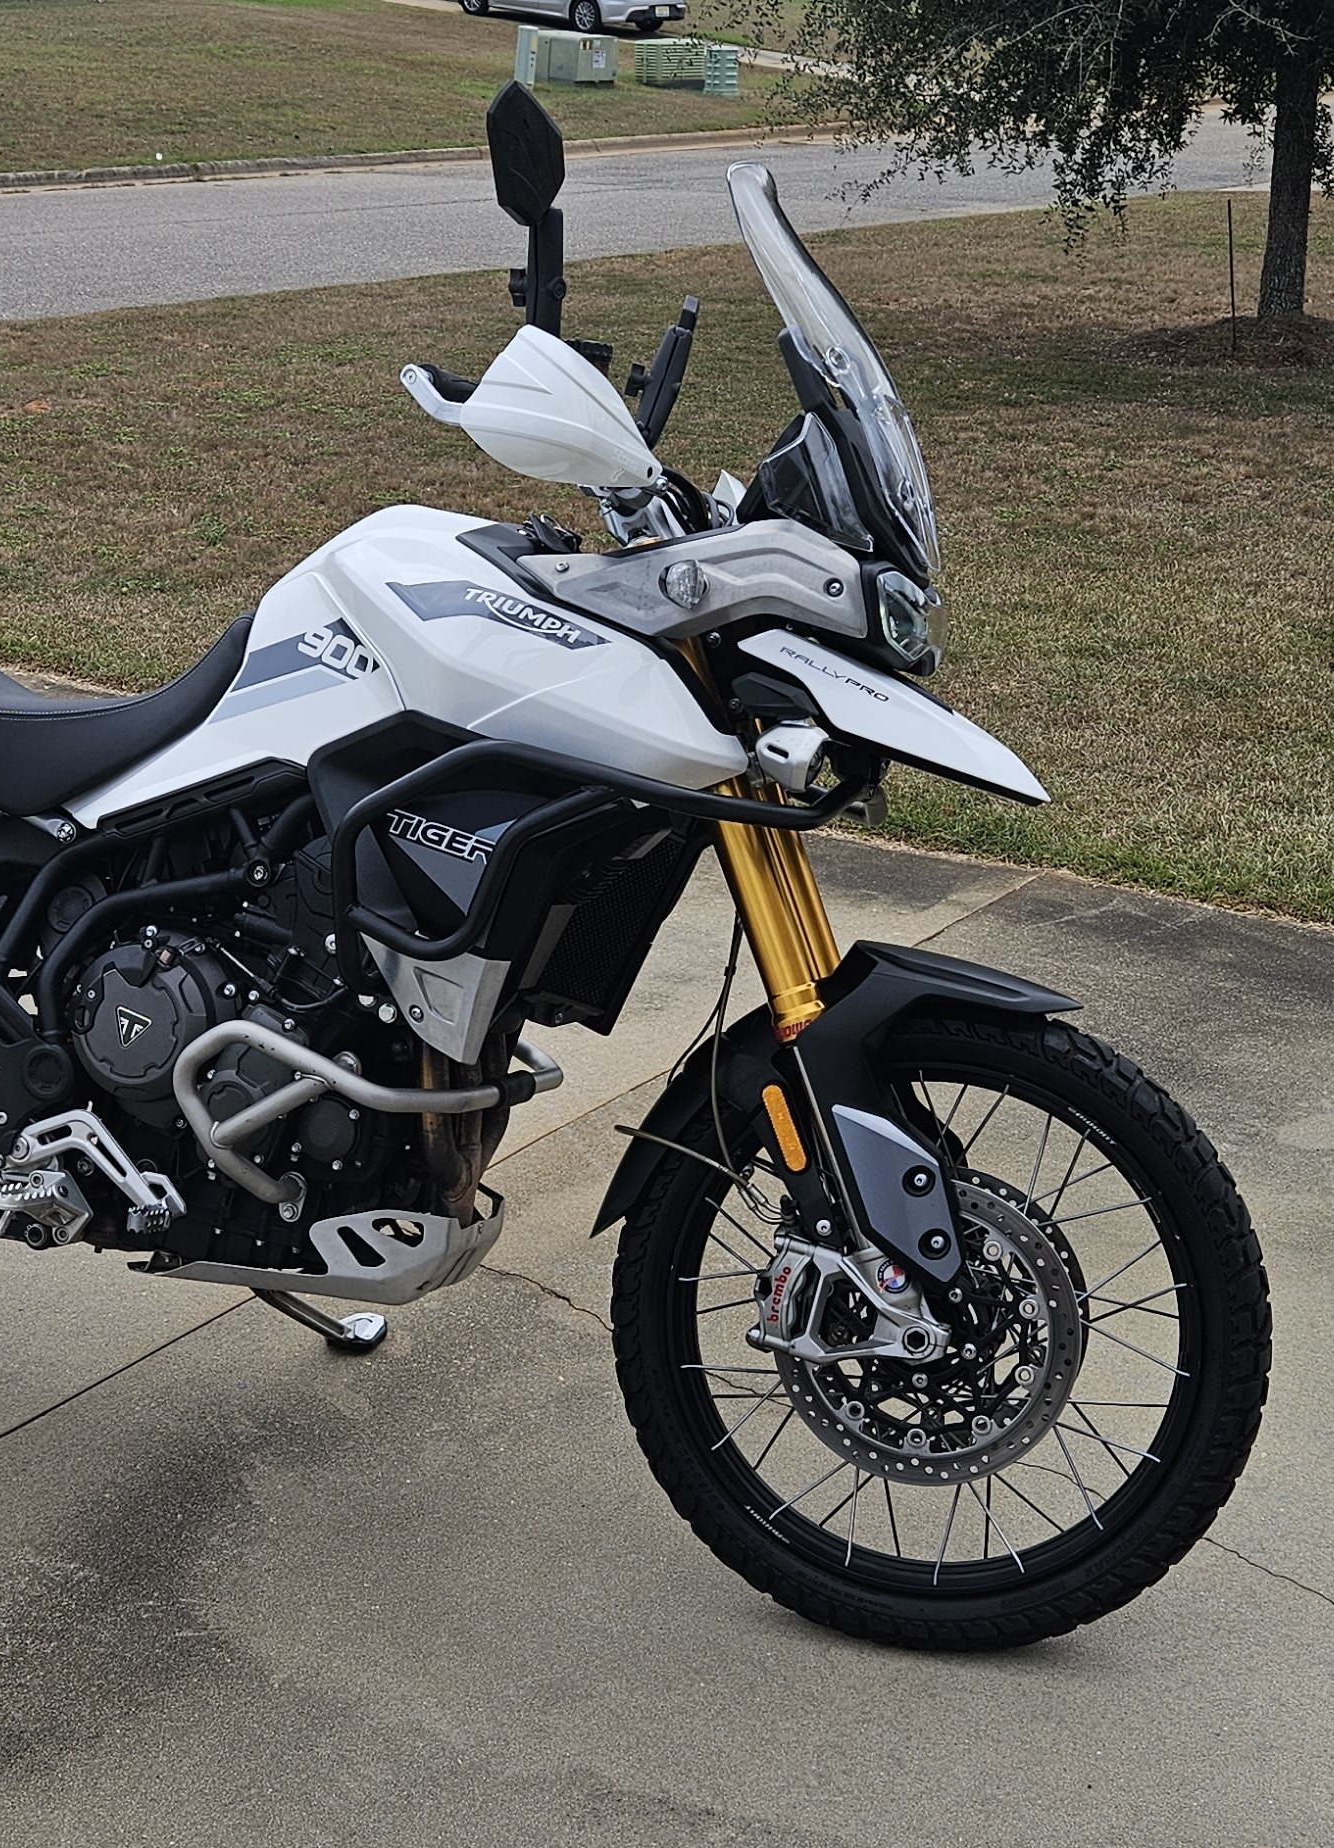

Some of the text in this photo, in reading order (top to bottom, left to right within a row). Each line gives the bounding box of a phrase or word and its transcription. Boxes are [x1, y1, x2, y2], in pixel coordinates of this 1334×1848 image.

[464, 588, 582, 644] TRIUMPH
[297, 625, 374, 678] 900
[766, 1266, 792, 1323] brembo
